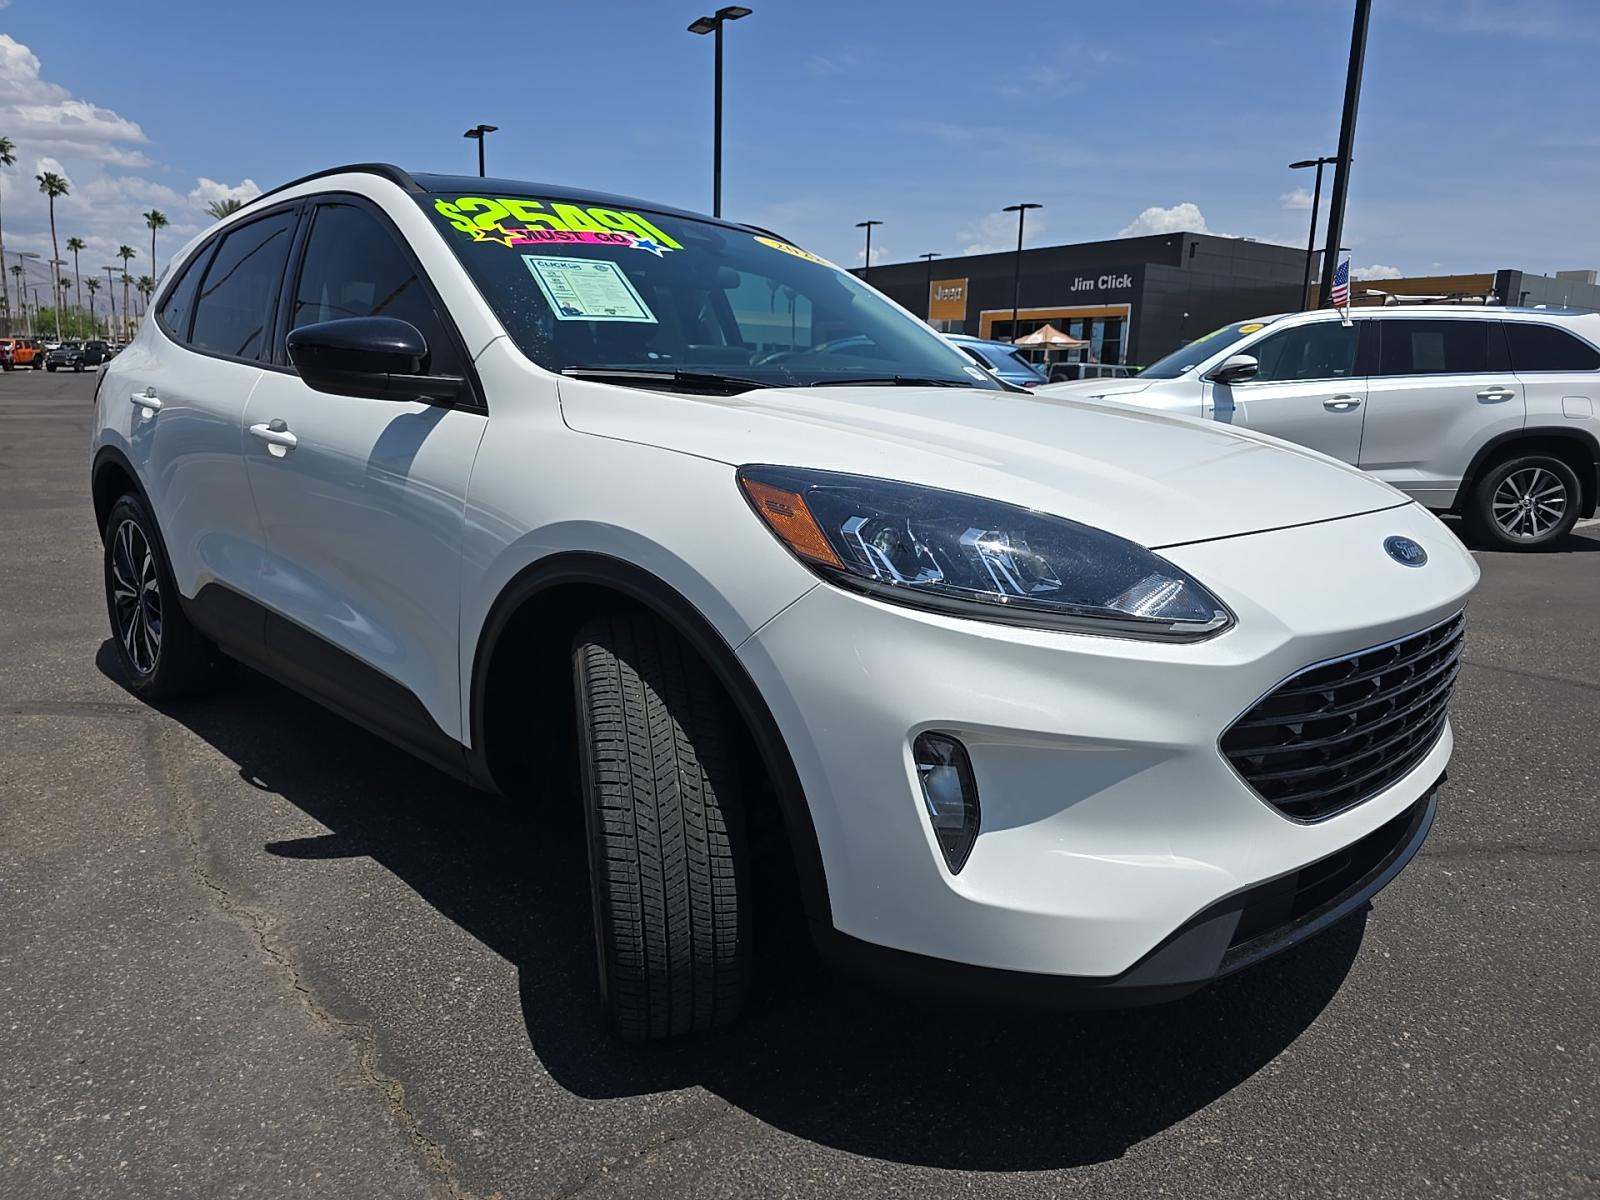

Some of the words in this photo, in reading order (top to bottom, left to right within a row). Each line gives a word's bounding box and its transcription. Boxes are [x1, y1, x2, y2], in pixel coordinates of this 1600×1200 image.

[434, 197, 685, 250] $25491
[518, 230, 583, 241] MUST
[1071, 276, 1094, 292] Jim
[1098, 273, 1133, 290] Click
[934, 285, 963, 302] Jeep
